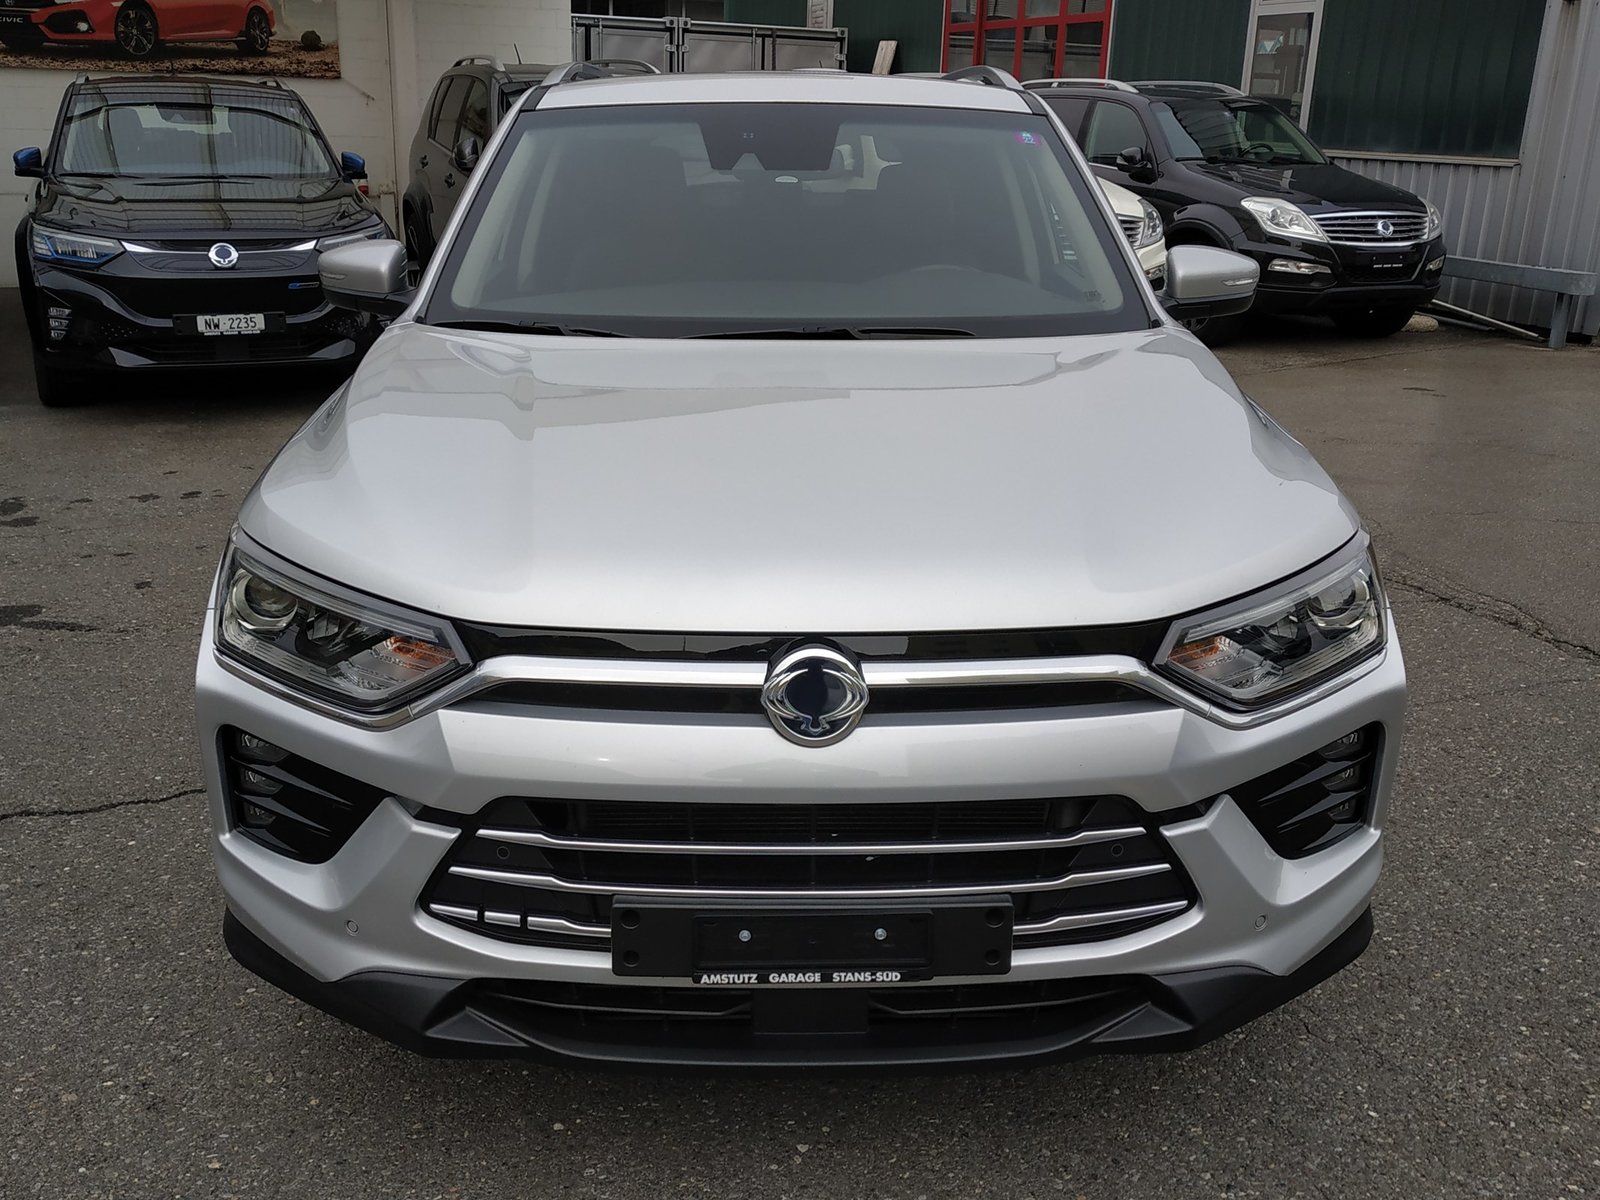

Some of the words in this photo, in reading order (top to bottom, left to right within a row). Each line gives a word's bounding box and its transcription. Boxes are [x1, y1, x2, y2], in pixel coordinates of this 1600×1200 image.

[204, 318, 220, 330] NW
[228, 316, 257, 330] 2235
[700, 973, 758, 984] AMSTUTZ
[769, 972, 821, 983] GARAGE
[832, 971, 901, 982] STANS-SÜD
